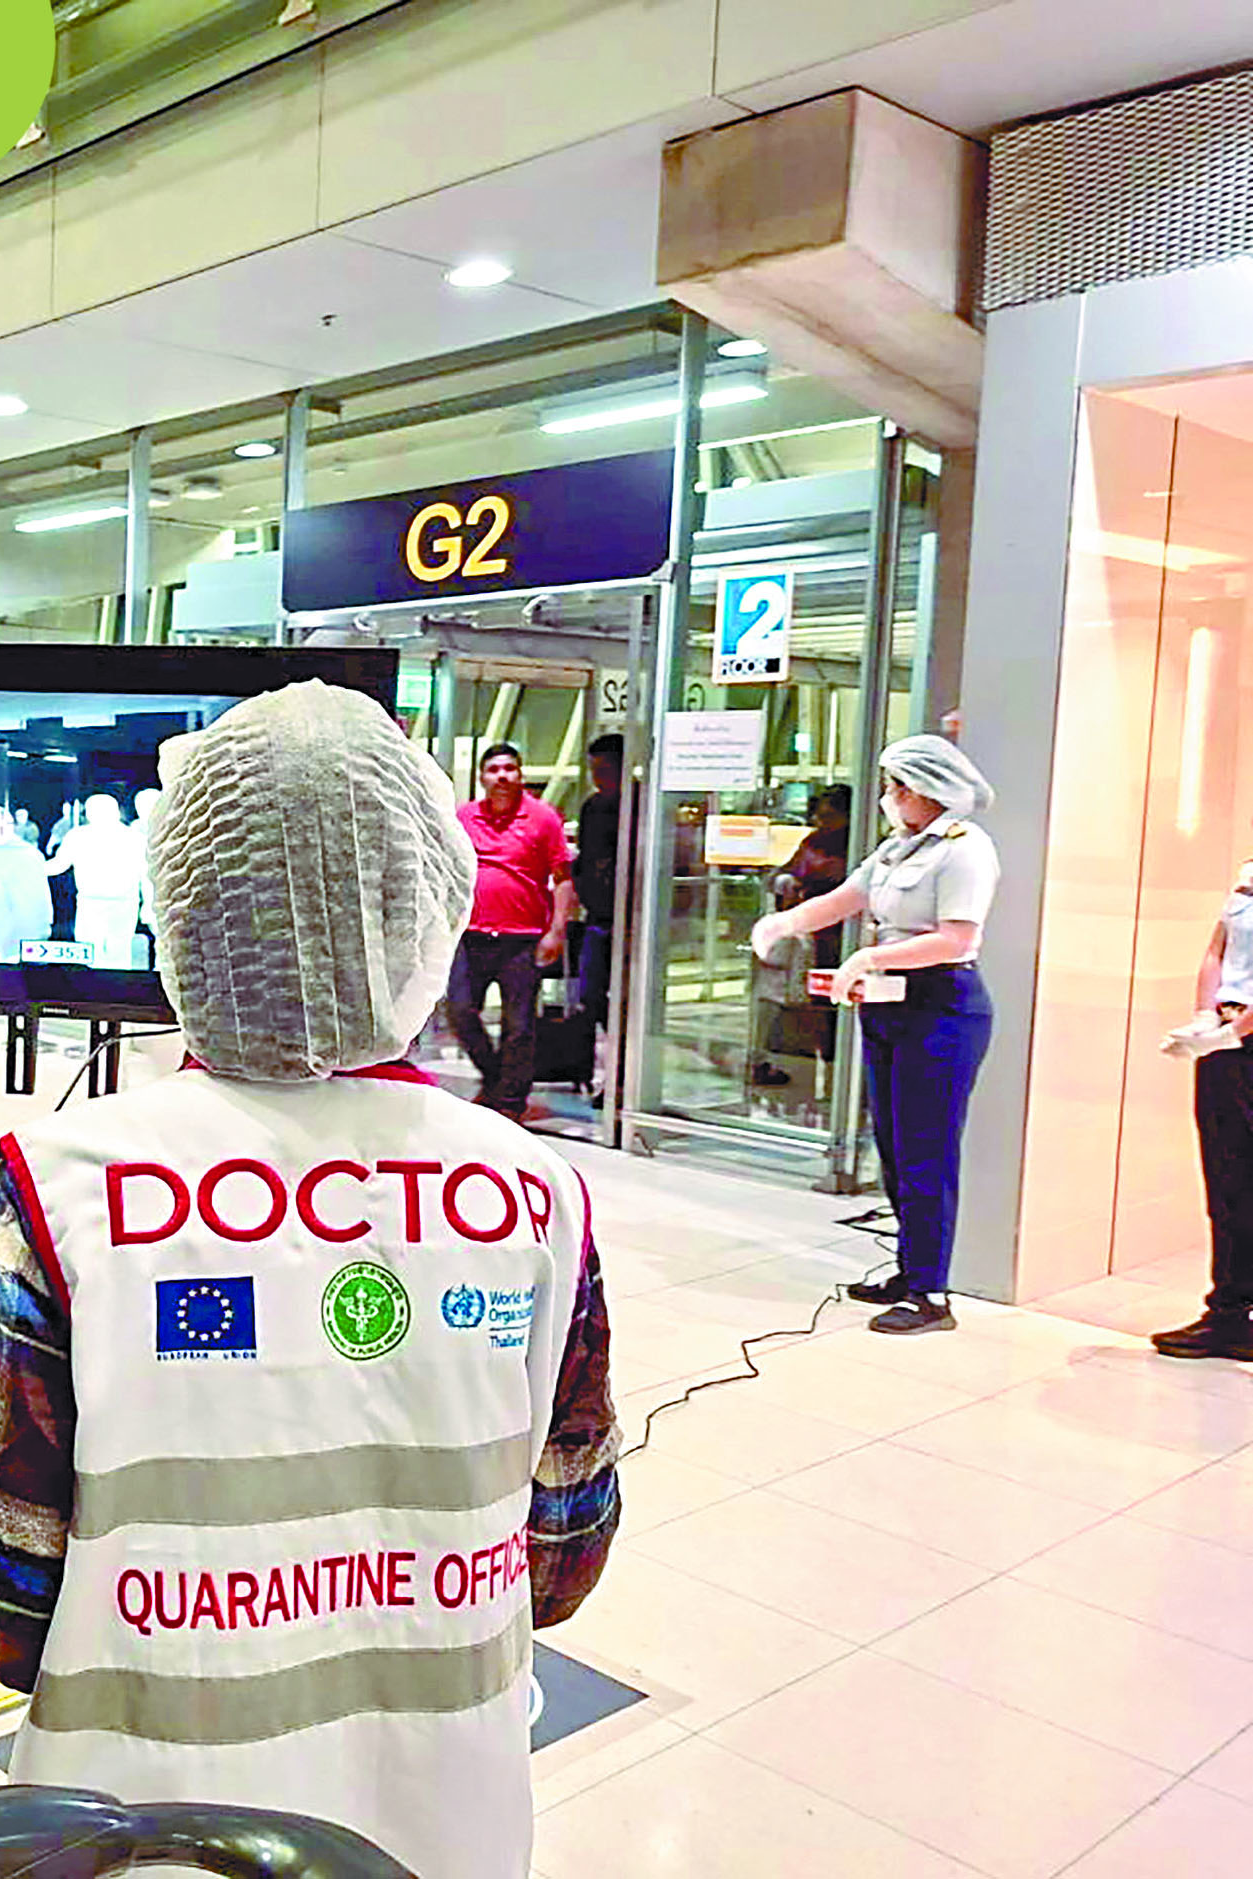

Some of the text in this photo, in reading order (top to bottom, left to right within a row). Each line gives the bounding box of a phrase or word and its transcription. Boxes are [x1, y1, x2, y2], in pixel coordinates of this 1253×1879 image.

[406, 495, 509, 582] G2
[737, 580, 785, 654] 2
[106, 1158, 552, 1247] DOCTOR
[117, 1551, 416, 1636] QUARANTINE
